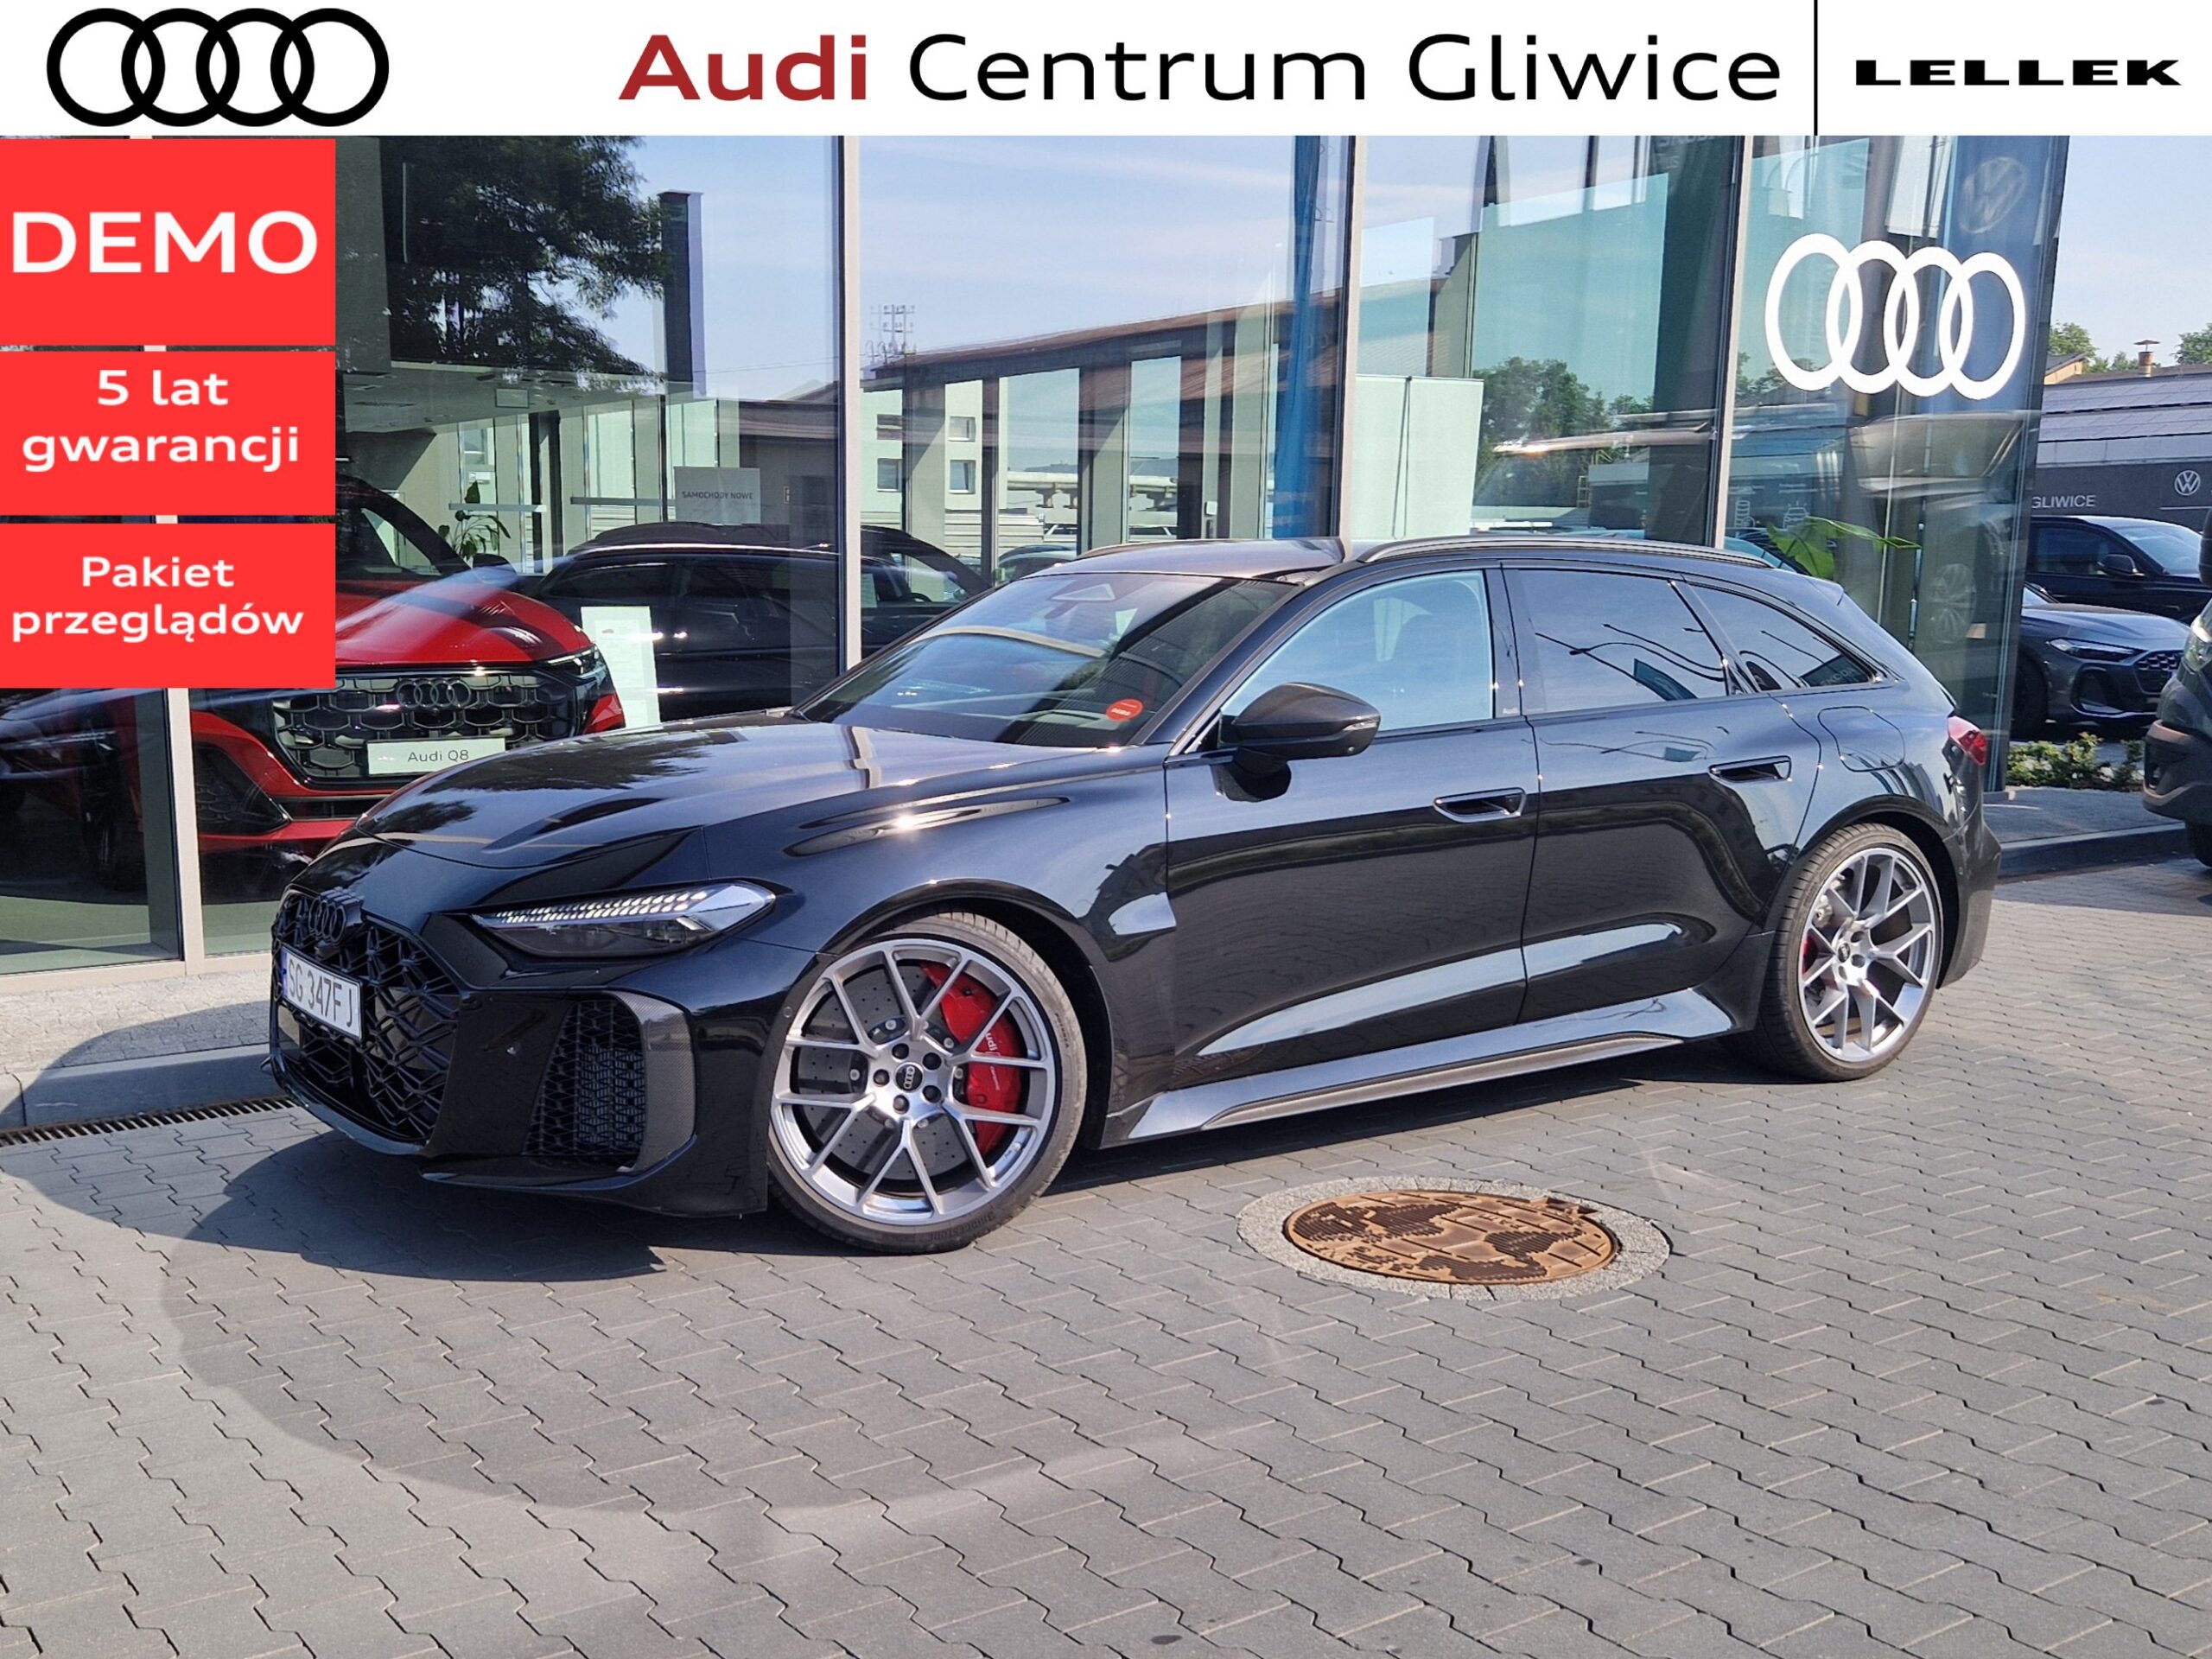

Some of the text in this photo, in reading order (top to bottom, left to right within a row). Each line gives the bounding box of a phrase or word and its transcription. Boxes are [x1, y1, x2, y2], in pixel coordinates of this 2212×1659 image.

[682, 491, 728, 499] SAMOCHODY
[2031, 494, 2098, 509] GLIWICE
[407, 749, 469, 762] Audi Q8
[289, 958, 303, 1003] SG
